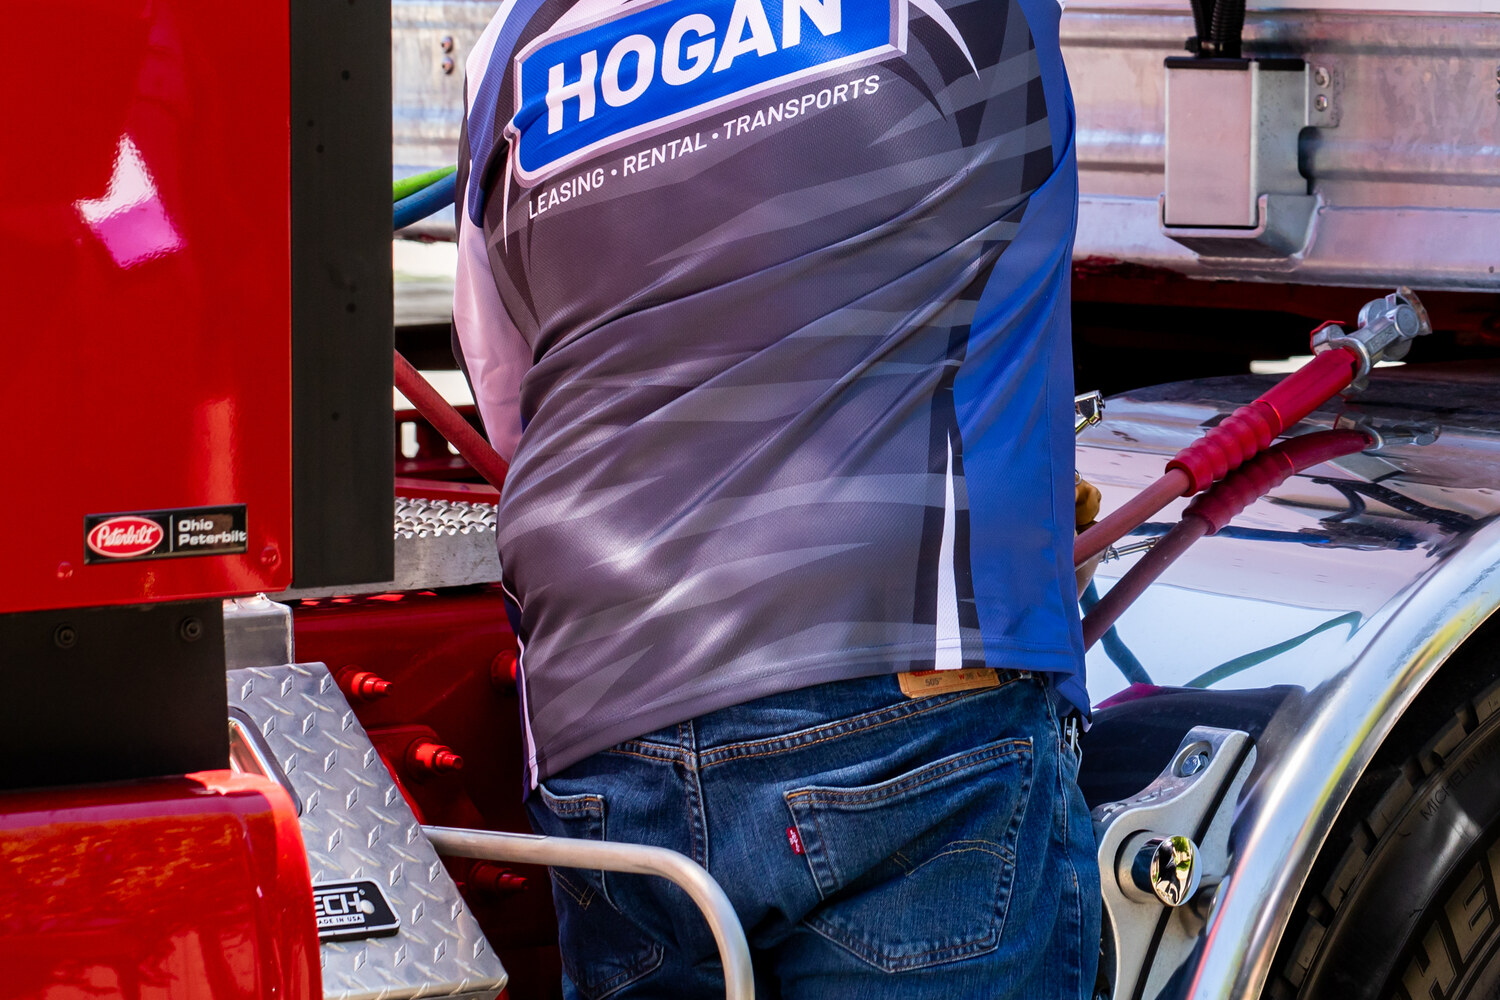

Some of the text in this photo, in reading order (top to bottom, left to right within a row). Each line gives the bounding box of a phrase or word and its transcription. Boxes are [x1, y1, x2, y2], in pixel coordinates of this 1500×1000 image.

[528, 73, 881, 221] LEASING RENTAL TRANSPORTS
[178, 518, 213, 532] Ohio
[97, 525, 159, 548] Peterbilt
[178, 530, 247, 547] Peterbilt
[317, 917, 334, 926] ADE
[347, 915, 364, 923] USA
